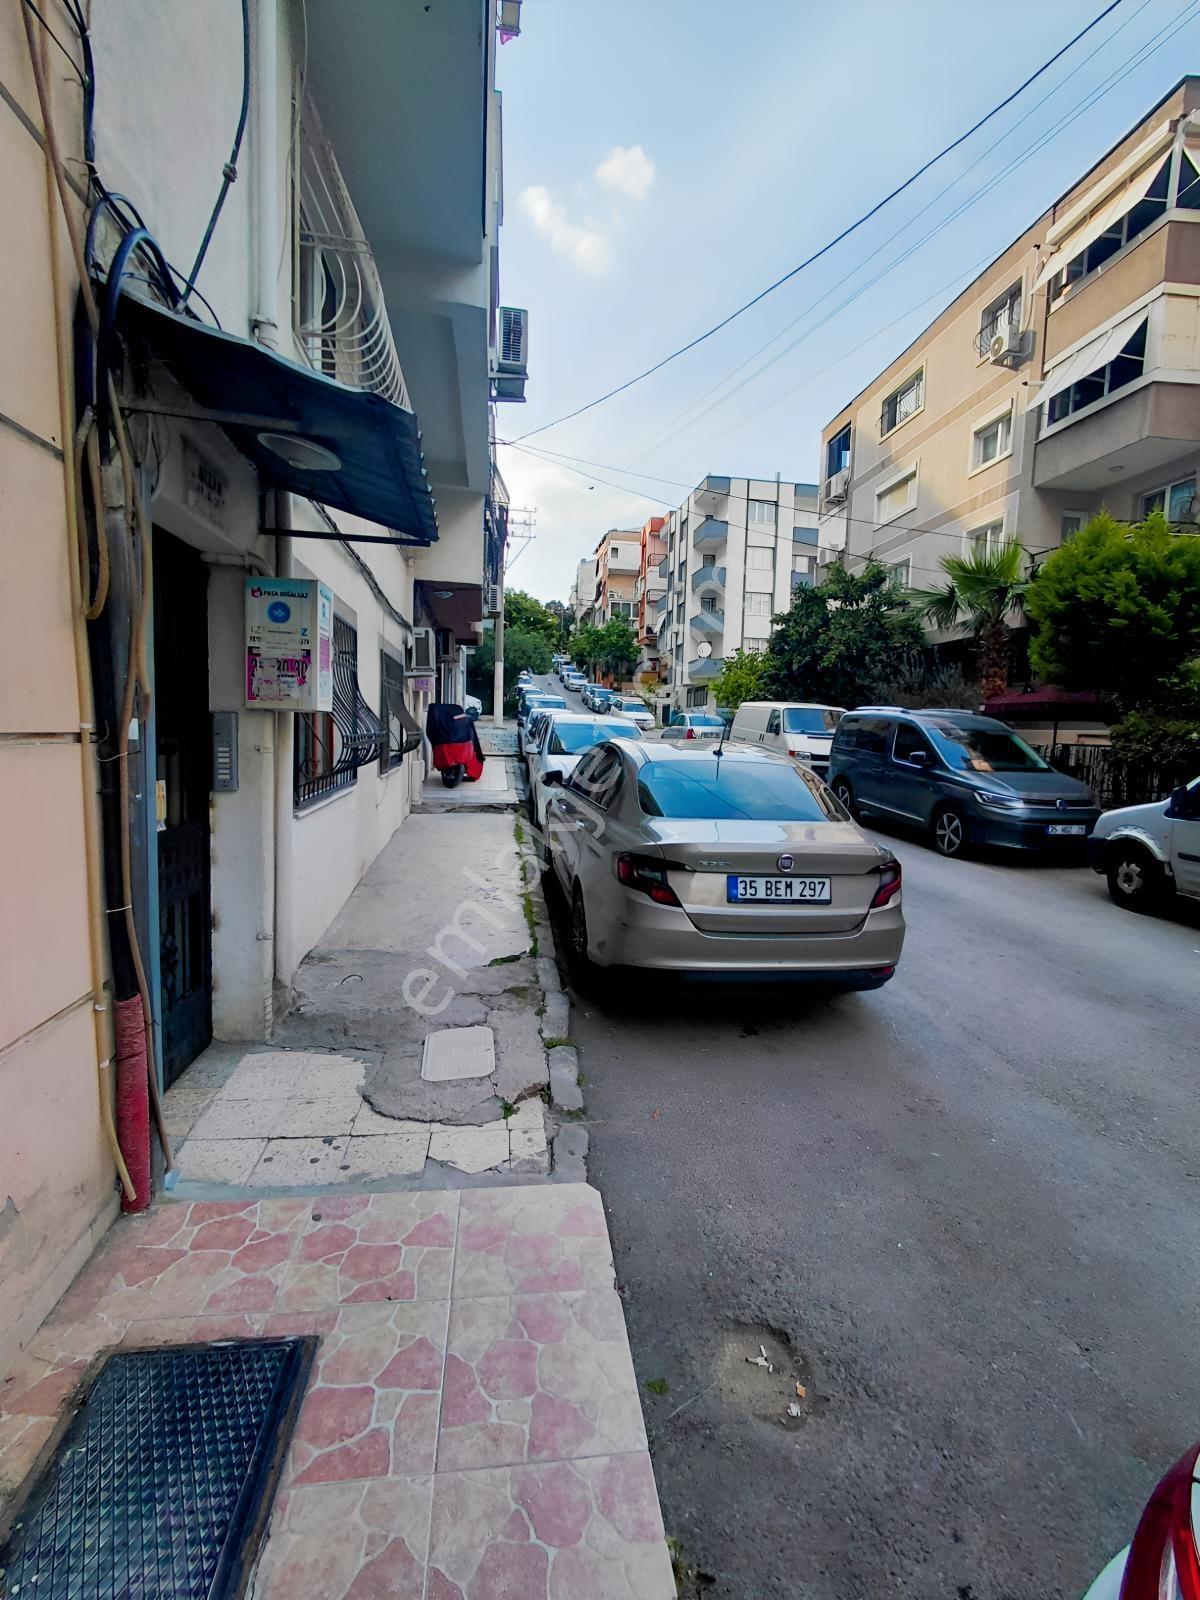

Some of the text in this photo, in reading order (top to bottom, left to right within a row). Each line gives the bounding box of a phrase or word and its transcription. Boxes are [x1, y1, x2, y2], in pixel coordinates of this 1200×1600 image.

[739, 880, 825, 898] 35 BEM 297
